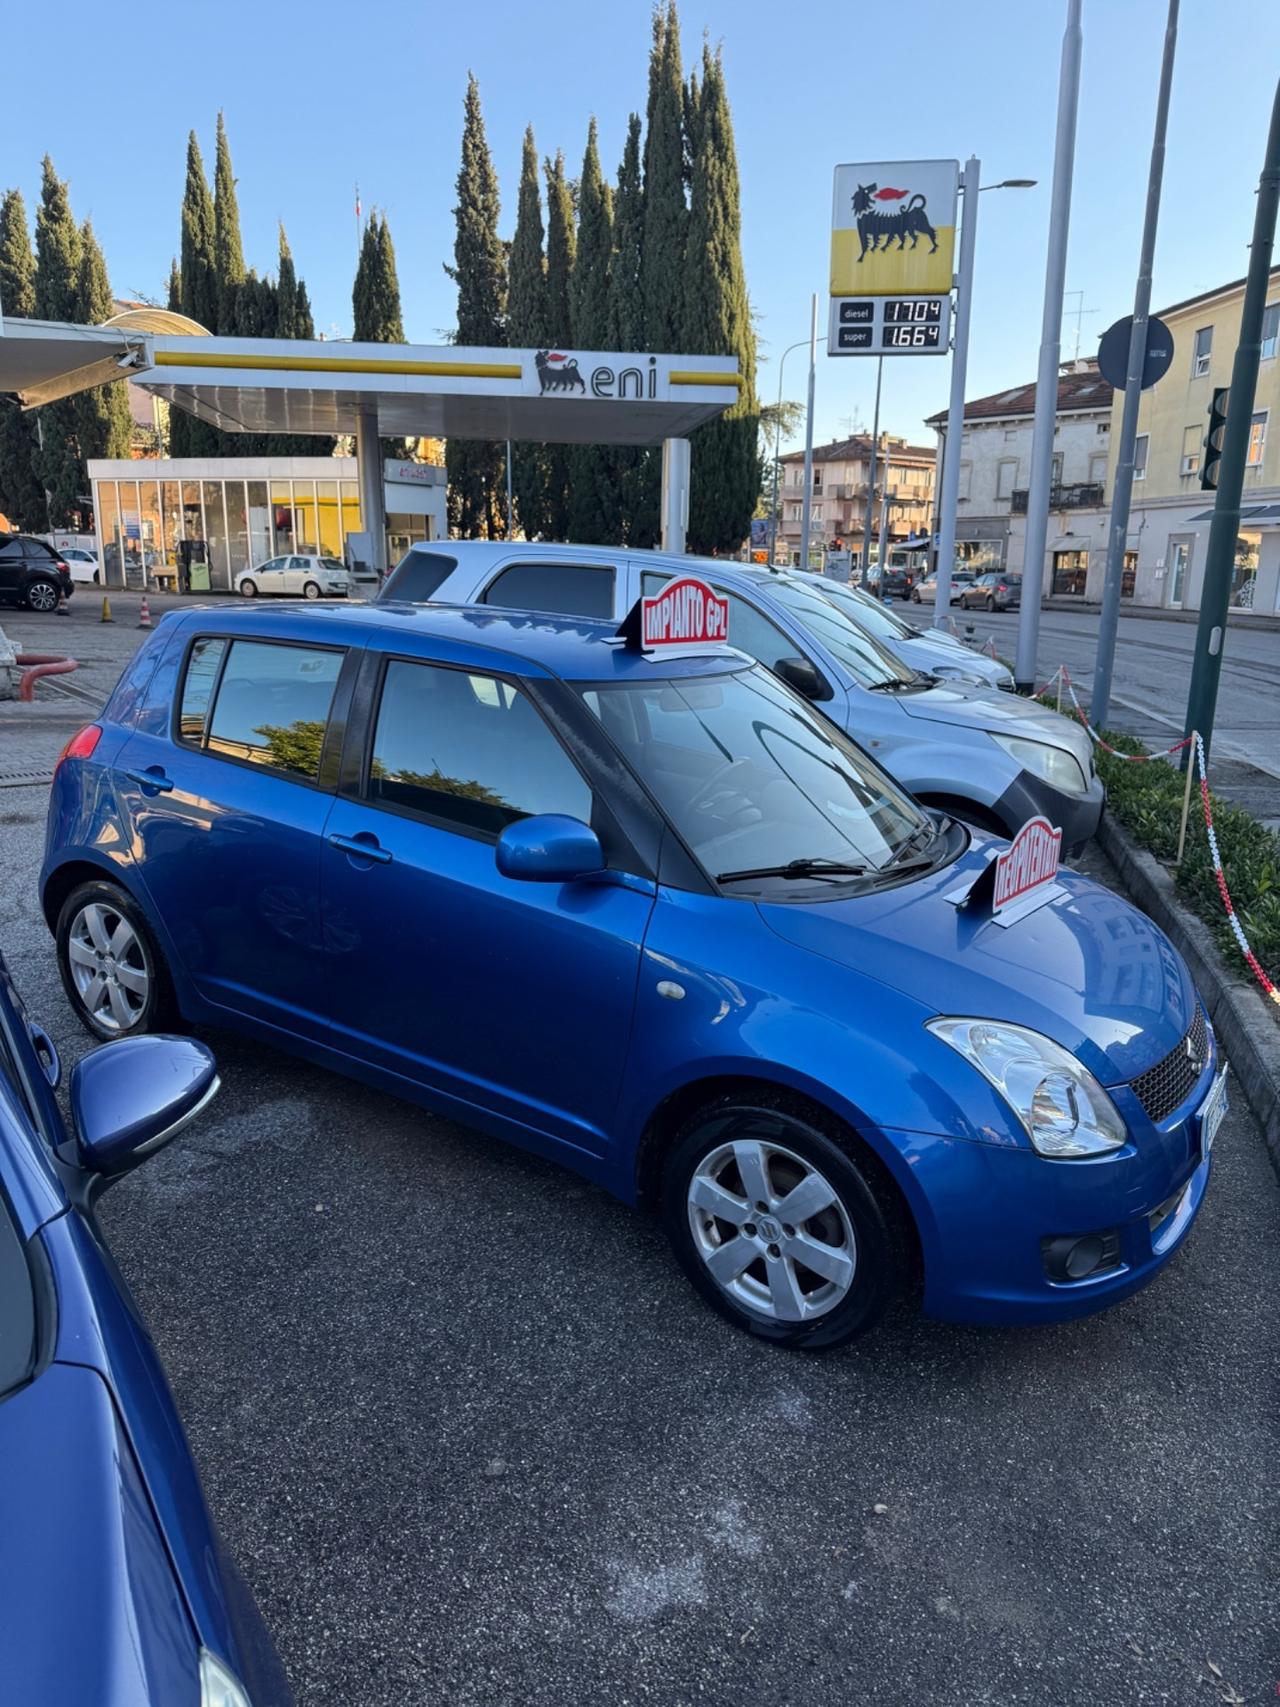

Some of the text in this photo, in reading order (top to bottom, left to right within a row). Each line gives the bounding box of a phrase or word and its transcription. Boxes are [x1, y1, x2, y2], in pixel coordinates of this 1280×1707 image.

[844, 309, 869, 319] diesel
[843, 333, 867, 343] super
[591, 356, 657, 399] eni
[646, 585, 727, 641] IMPIANTO GPL
